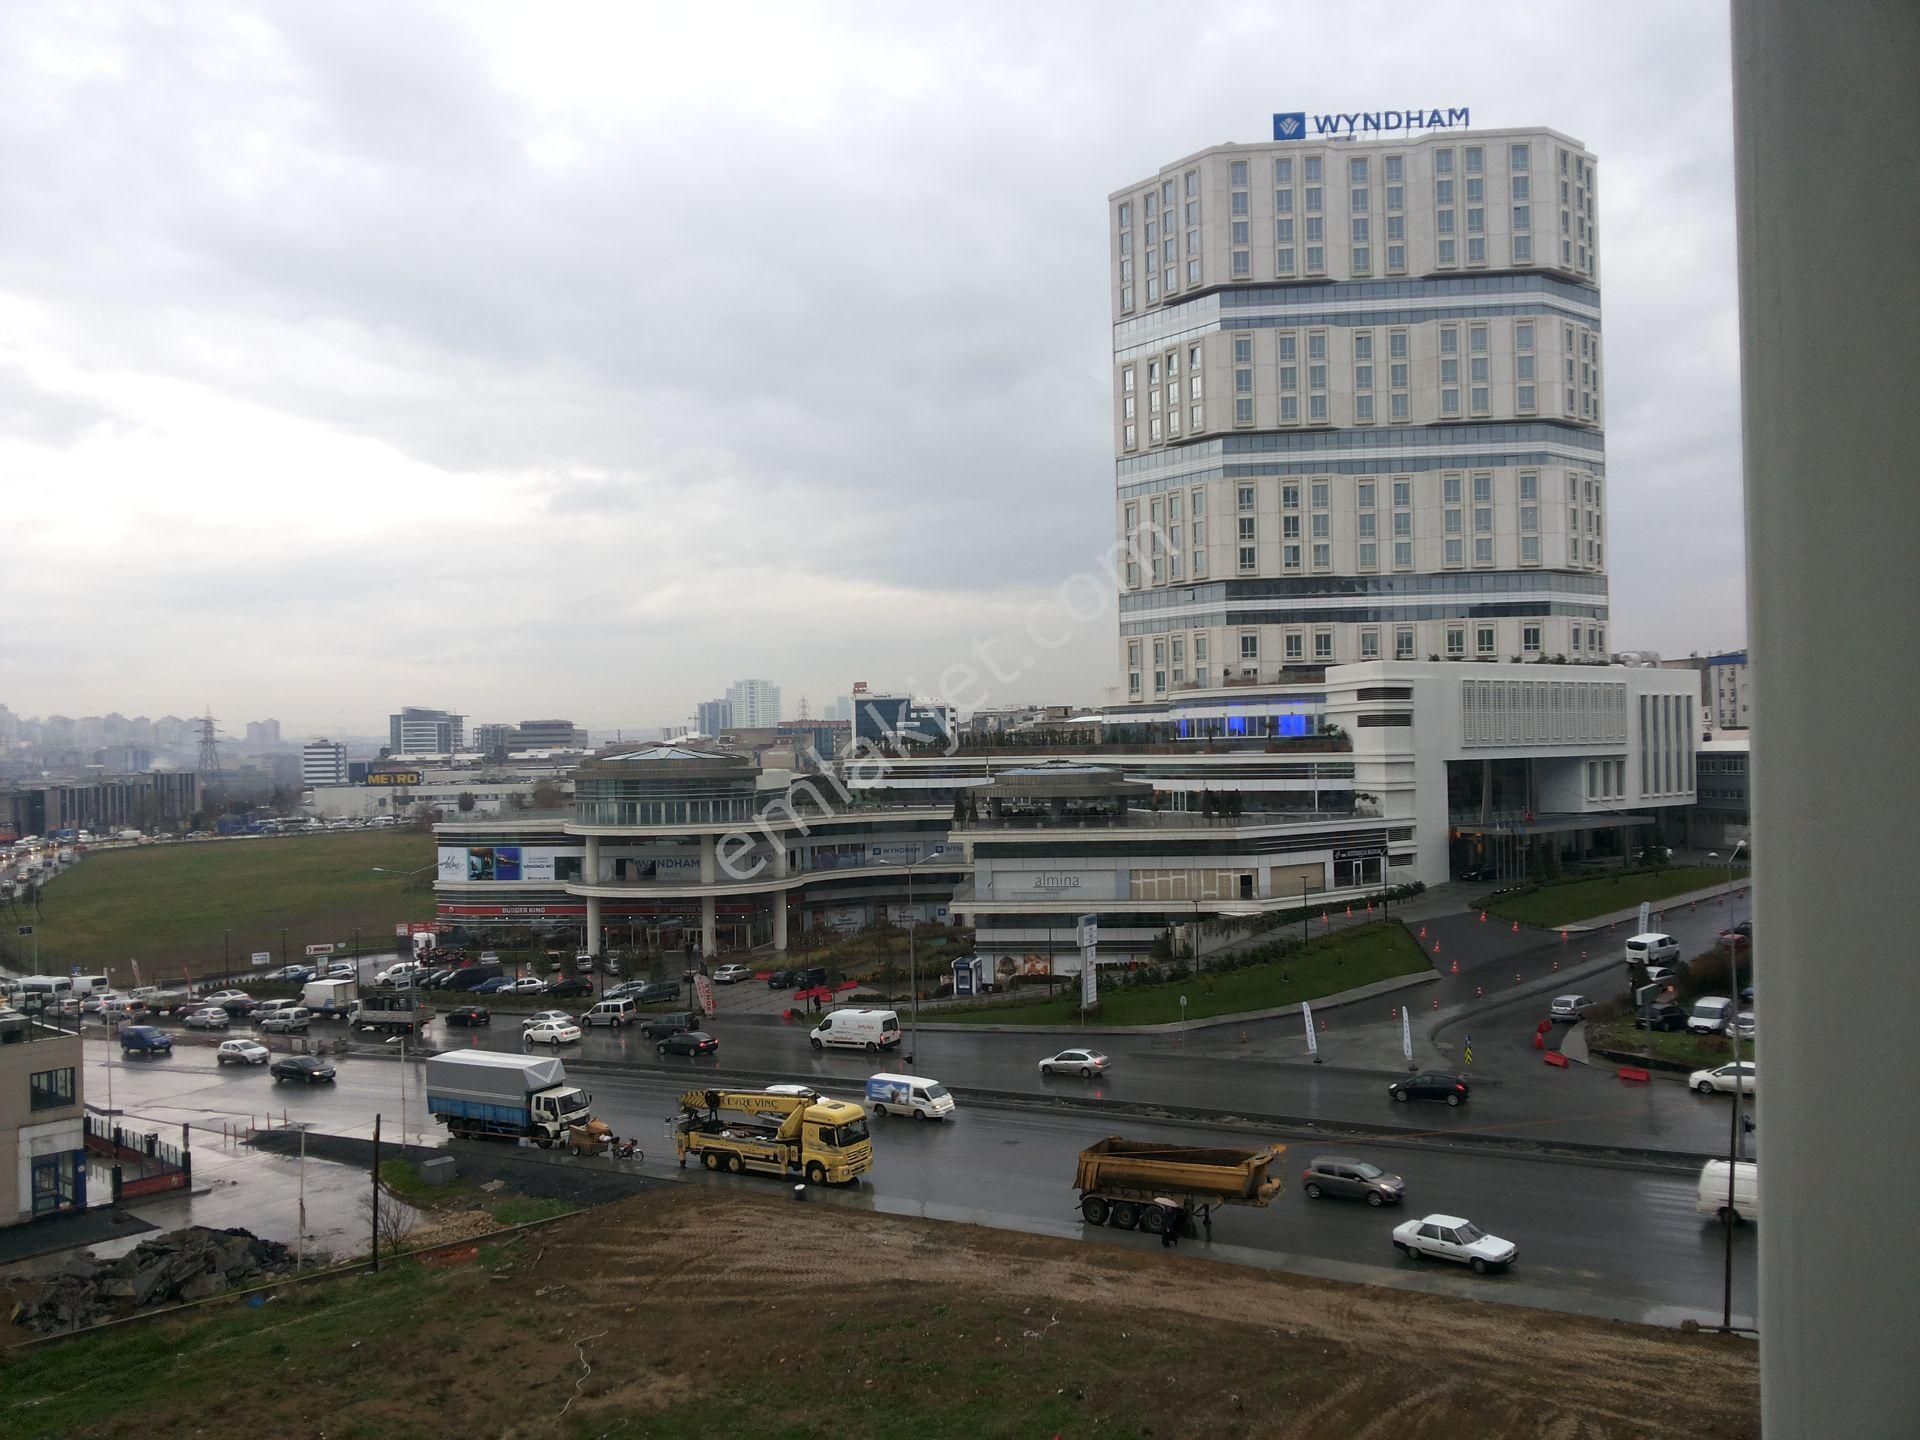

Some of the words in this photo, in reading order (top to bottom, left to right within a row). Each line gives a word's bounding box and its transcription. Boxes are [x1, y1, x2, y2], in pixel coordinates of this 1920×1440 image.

[1313, 107, 1470, 134] WYNDHAM
[367, 774, 418, 785] METRO
[883, 847, 921, 855] WYNDHAM
[1034, 871, 1080, 887] almina
